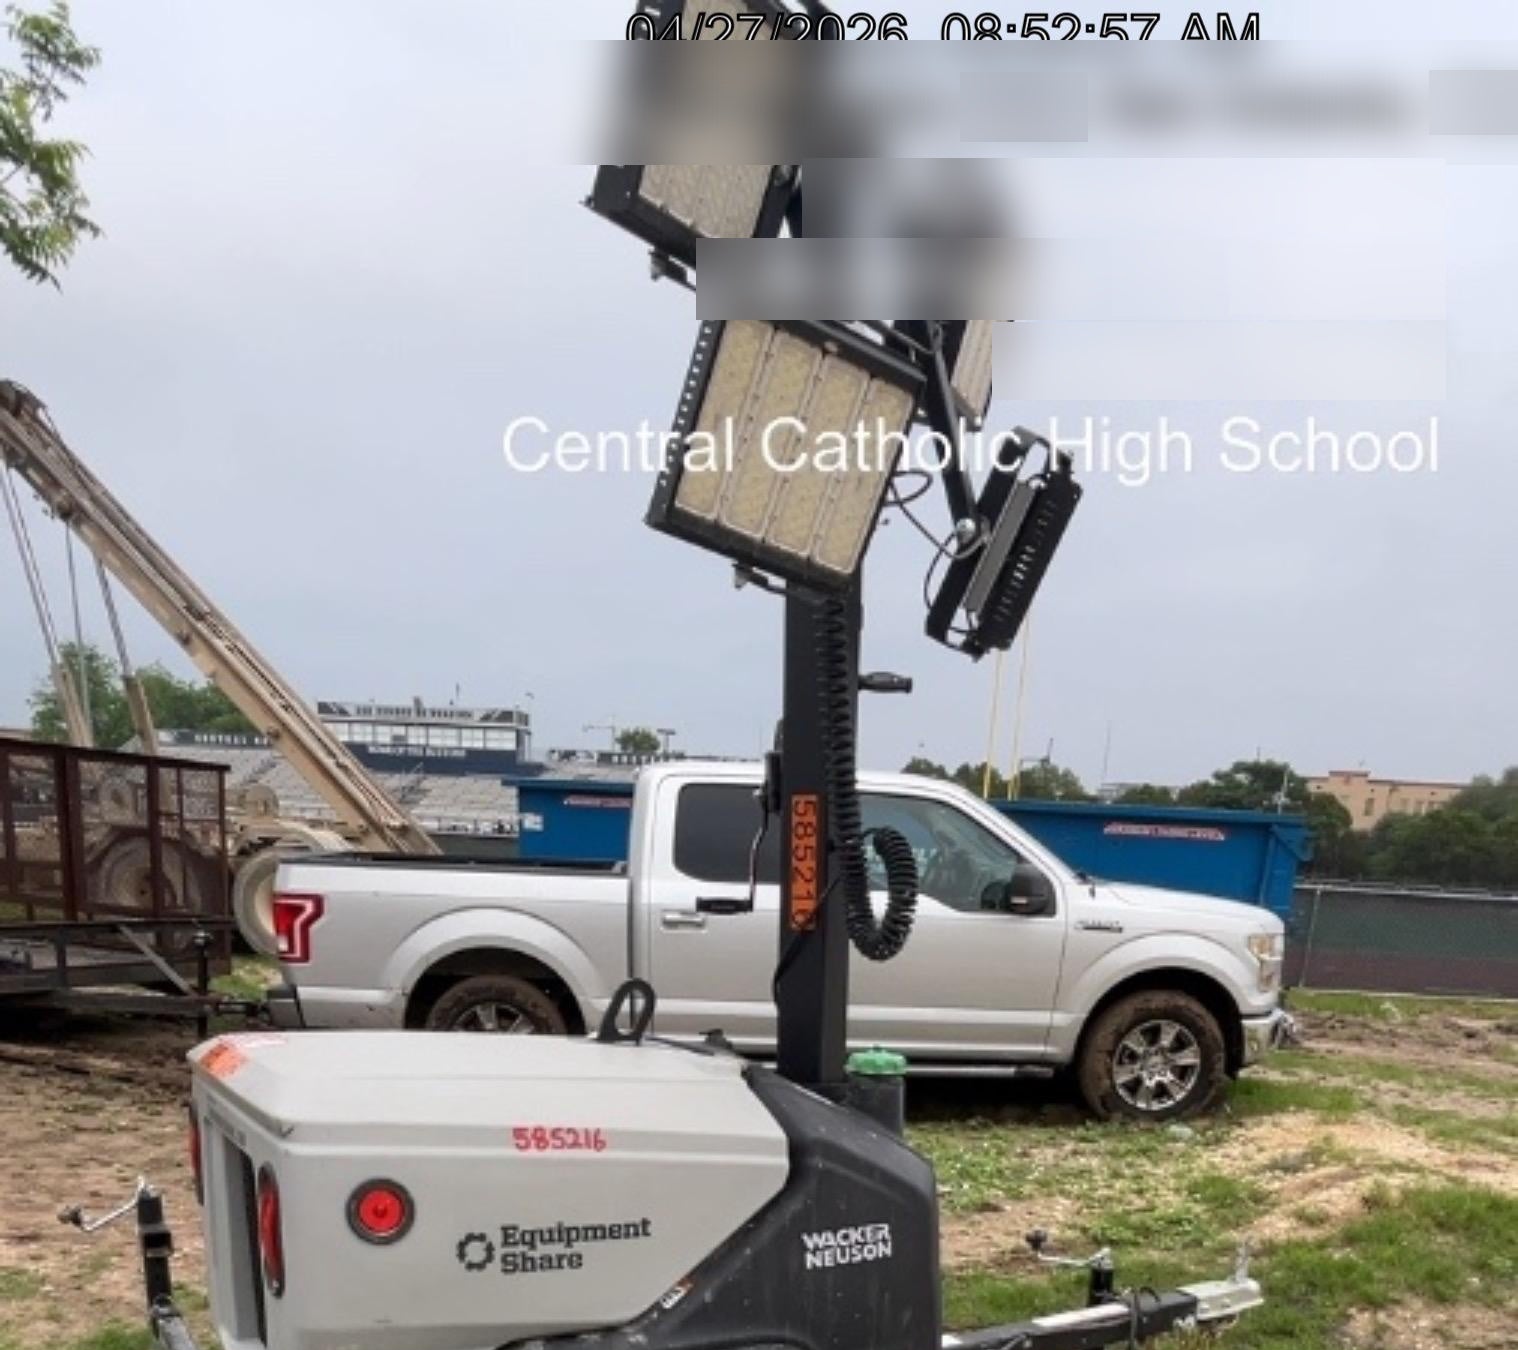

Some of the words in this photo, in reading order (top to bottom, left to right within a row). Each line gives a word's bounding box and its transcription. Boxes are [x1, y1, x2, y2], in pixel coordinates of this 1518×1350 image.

[512, 1126, 607, 1152] 585216
[500, 1217, 652, 1250] Equipment
[801, 1223, 889, 1250] WACKER
[500, 1251, 583, 1275] Share
[805, 1240, 892, 1270] NEUSON
